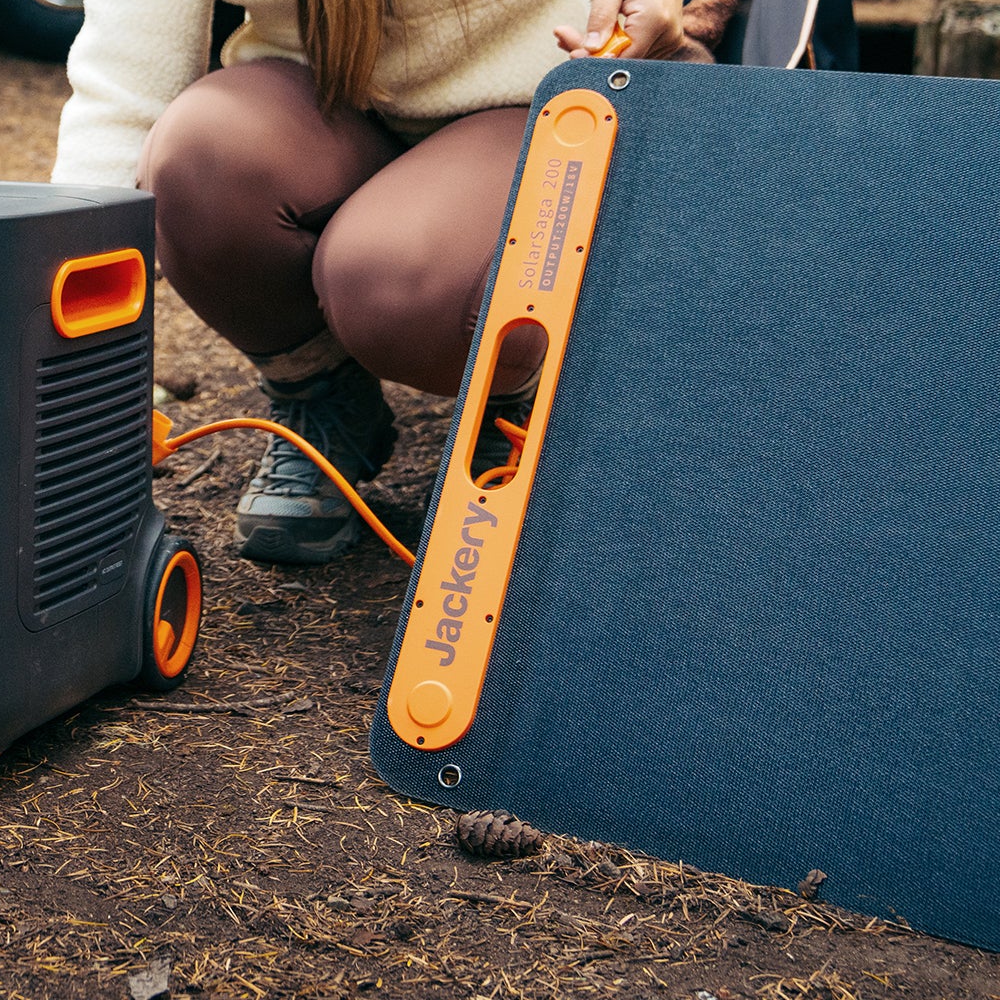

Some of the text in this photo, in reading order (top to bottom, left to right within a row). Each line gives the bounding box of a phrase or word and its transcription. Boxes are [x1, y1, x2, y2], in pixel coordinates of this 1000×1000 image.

[518, 158, 562, 289] SolarSaga 200
[424, 501, 499, 667] Jackery
